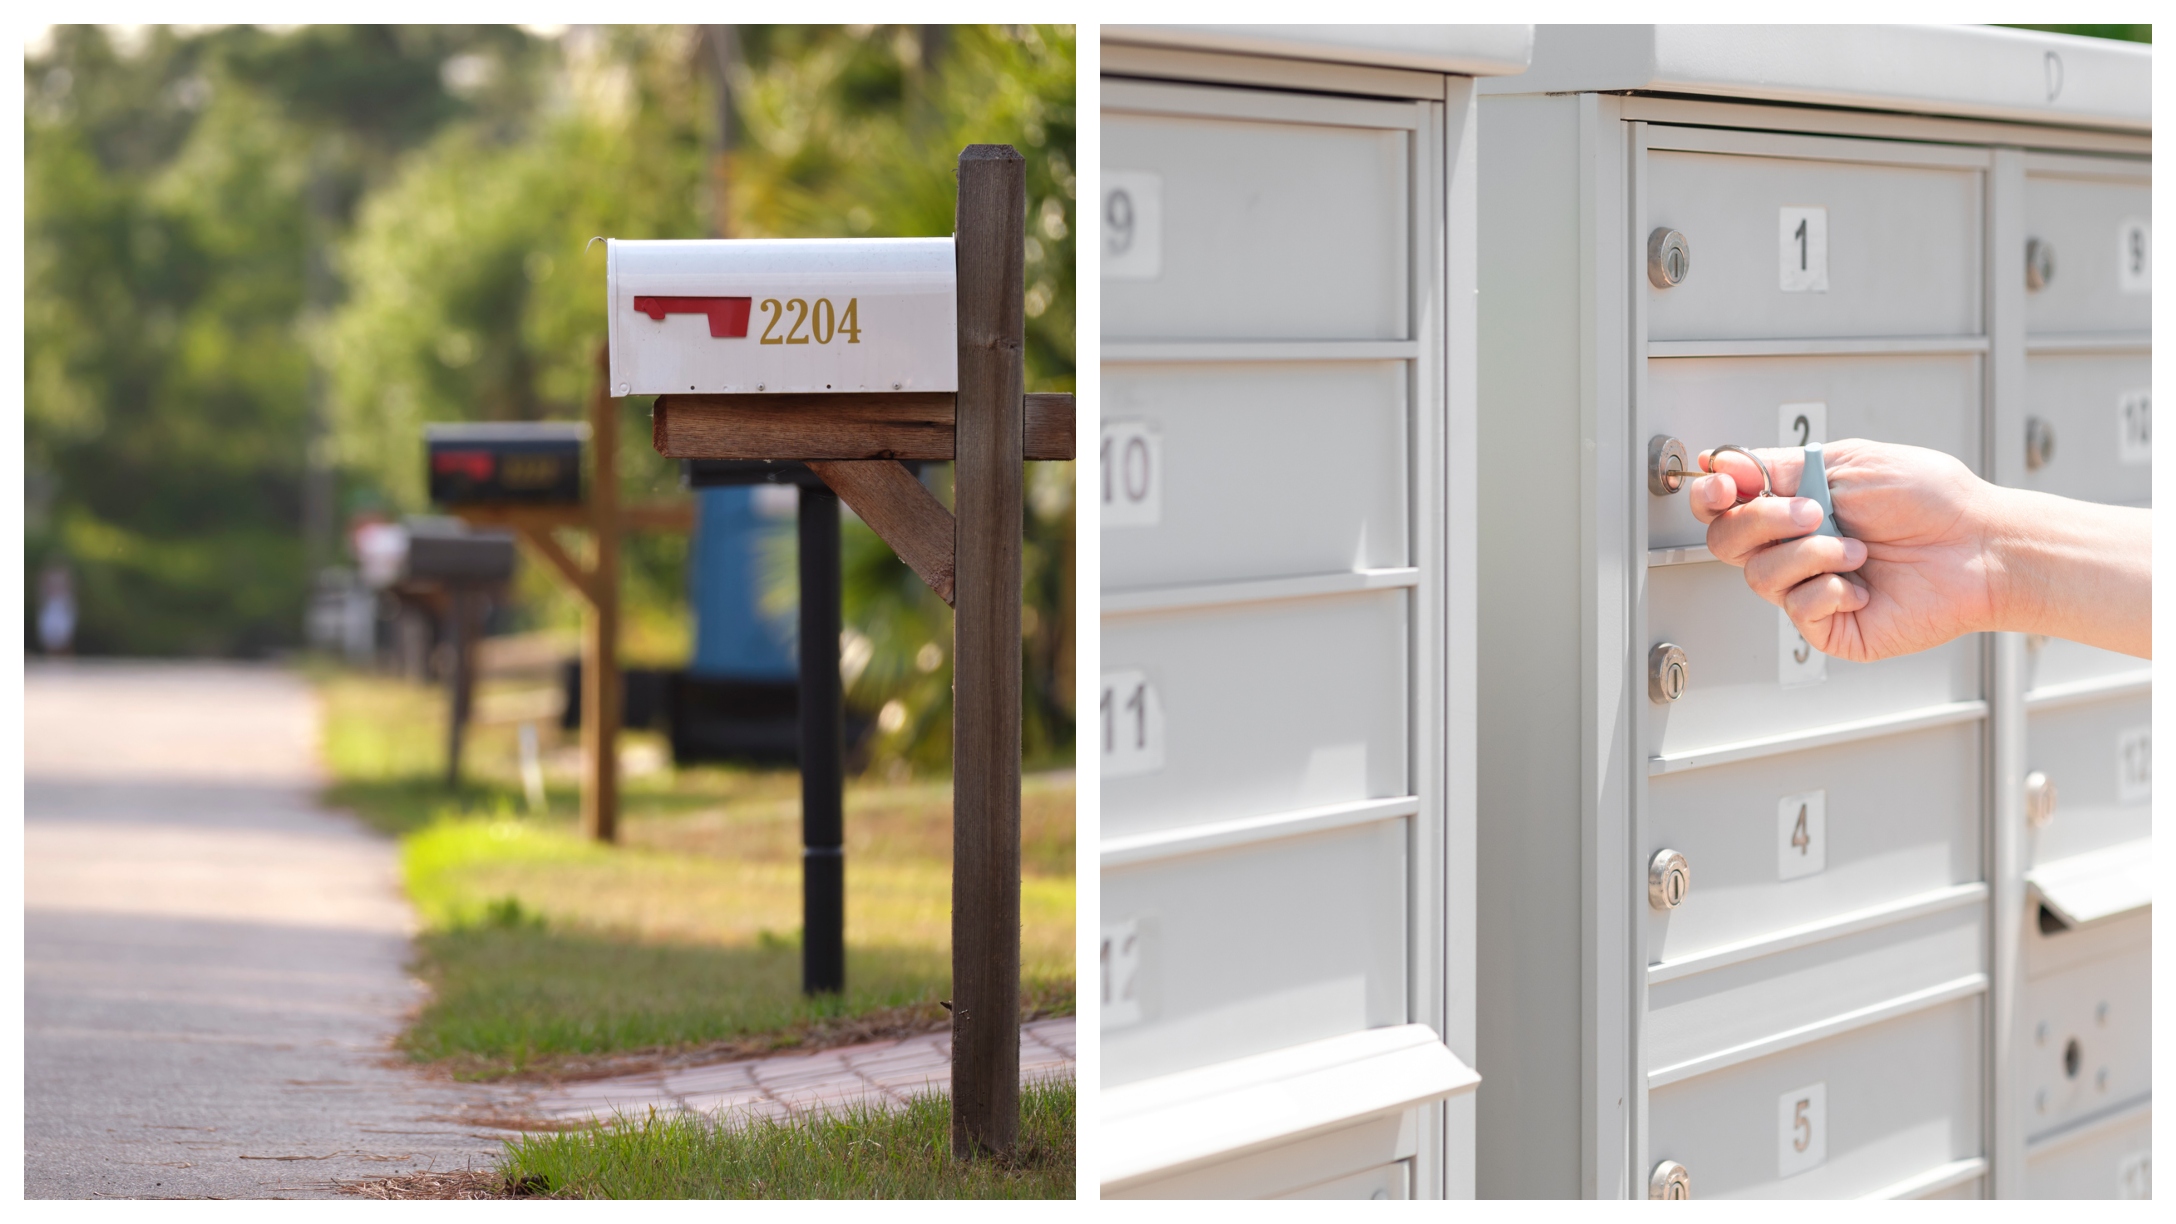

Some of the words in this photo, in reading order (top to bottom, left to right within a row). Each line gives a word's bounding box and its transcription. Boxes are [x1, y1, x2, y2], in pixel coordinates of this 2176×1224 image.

[2043, 50, 2065, 102] D
[1103, 186, 1137, 256] 9
[1794, 218, 1807, 272] 1
[759, 297, 862, 345] 2204
[1793, 414, 1810, 446] 2
[1099, 435, 1150, 505] 10
[1099, 683, 1147, 754] 11
[1791, 802, 1811, 857] 4
[1792, 1098, 1812, 1154] 5
